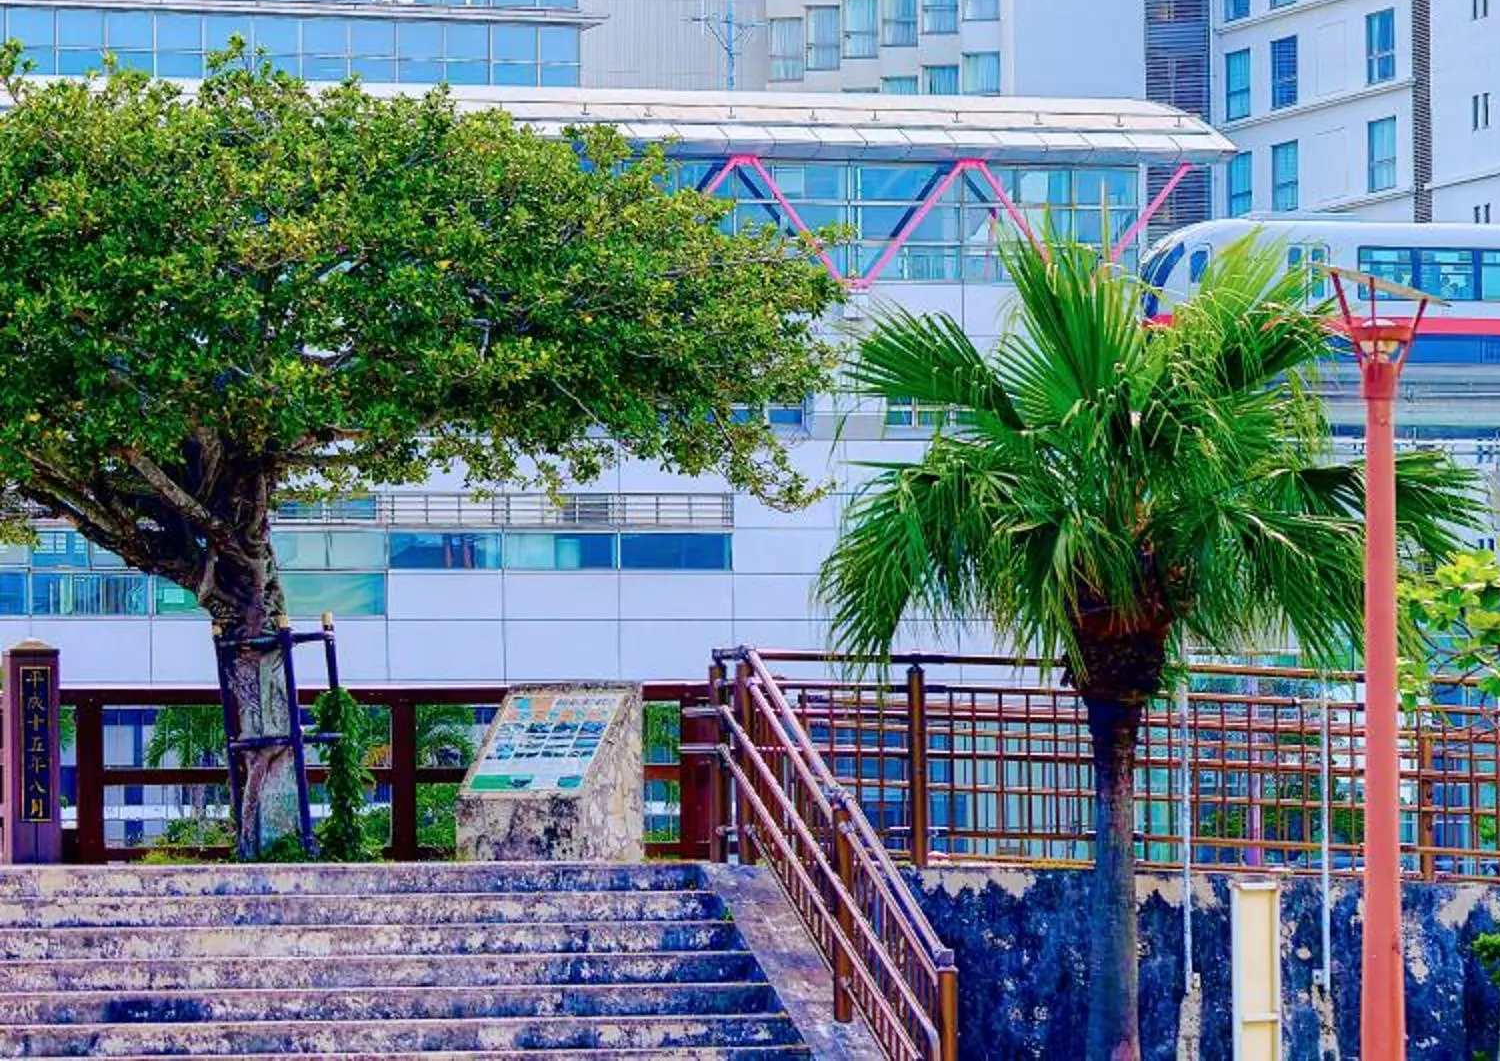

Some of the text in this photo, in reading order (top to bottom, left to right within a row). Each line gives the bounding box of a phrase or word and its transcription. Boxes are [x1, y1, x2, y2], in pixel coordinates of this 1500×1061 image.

[26, 670, 46, 818] 平成十五年八月
